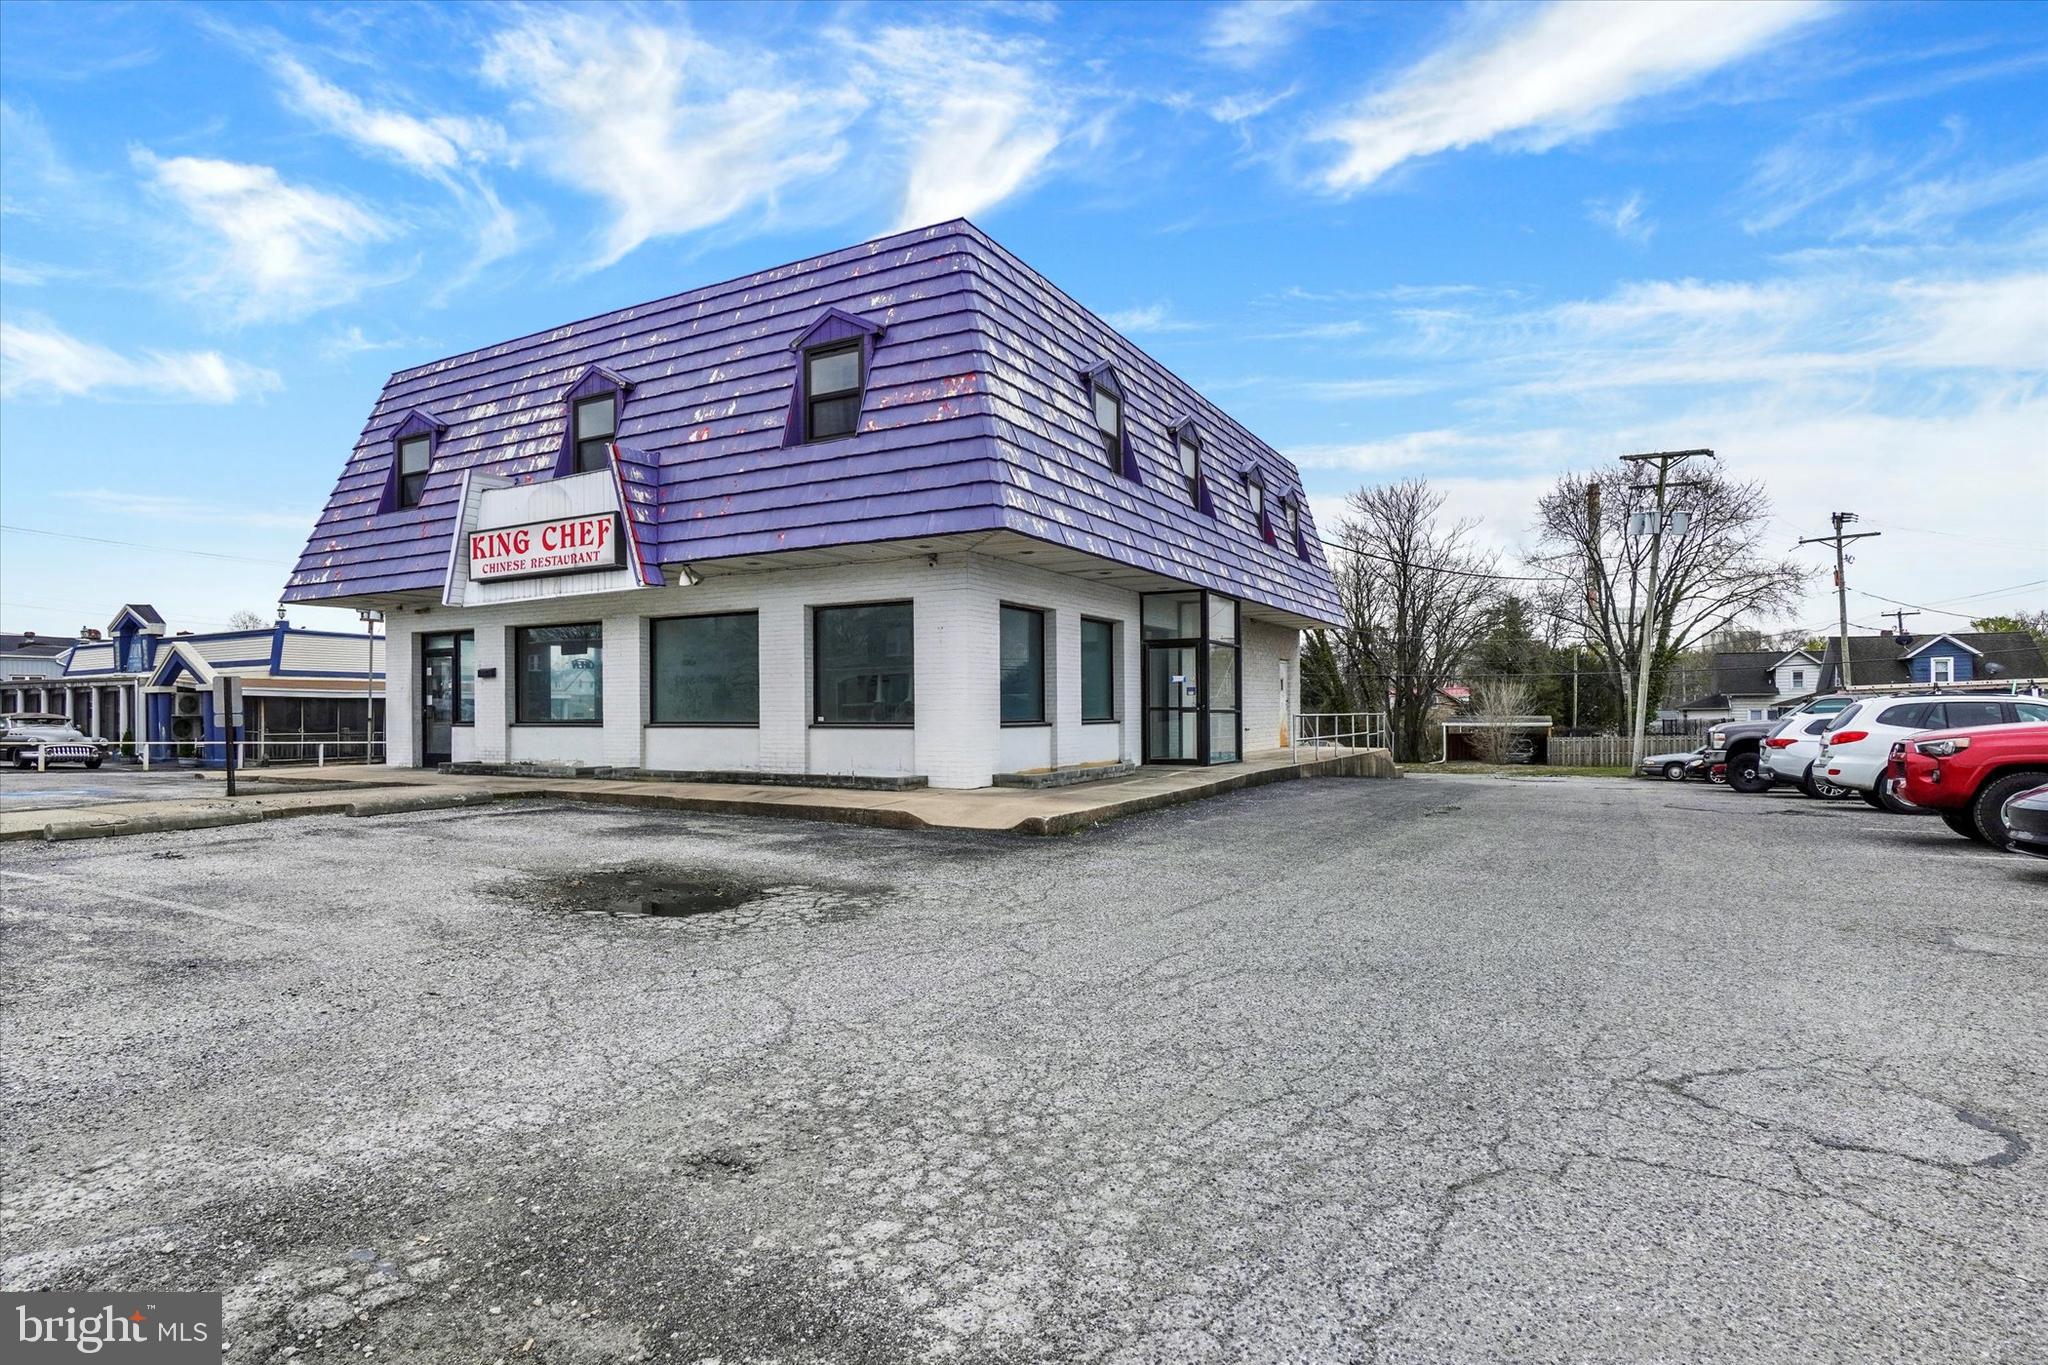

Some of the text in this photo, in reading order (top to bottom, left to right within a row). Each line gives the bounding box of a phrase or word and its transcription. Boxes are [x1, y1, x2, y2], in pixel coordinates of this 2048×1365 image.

[472, 518, 612, 560] KING CHEF
[482, 551, 601, 574] CHINESE RESTAURANT
